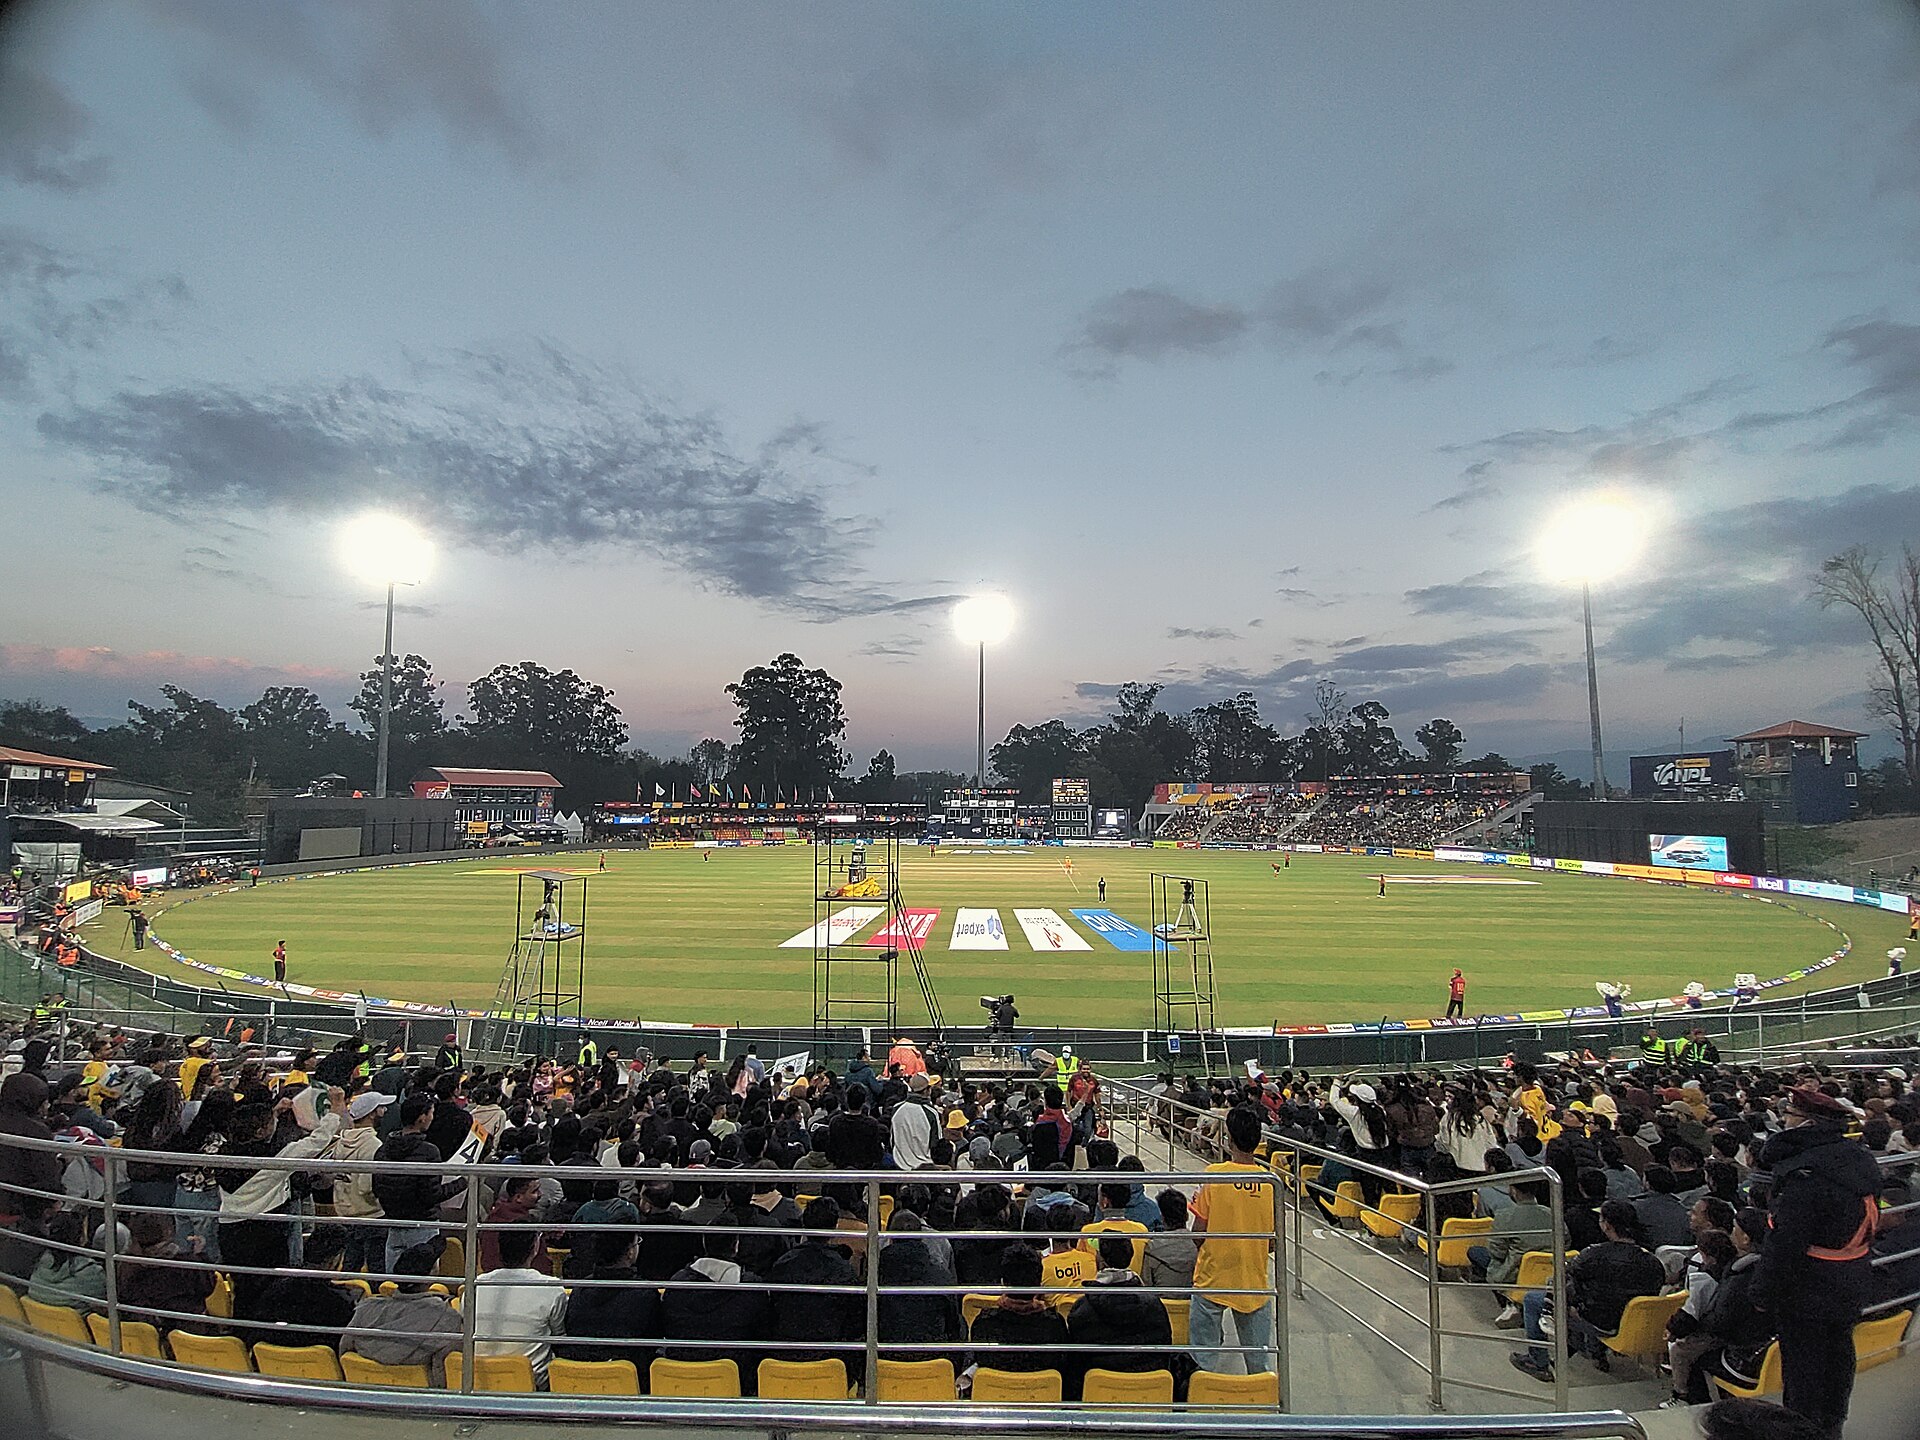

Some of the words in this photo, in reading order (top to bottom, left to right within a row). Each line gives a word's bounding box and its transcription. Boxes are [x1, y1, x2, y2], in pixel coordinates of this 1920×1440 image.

[1674, 767, 1711, 782] NPL
[1757, 876, 1784, 891] Ncell
[956, 922, 986, 938] expert
[1081, 914, 1139, 939] vivo
[588, 1018, 608, 1027] Ncell
[613, 1019, 635, 1028] Ncell
[1432, 1019, 1453, 1027] Ncell
[1055, 1262, 1081, 1279] baji
